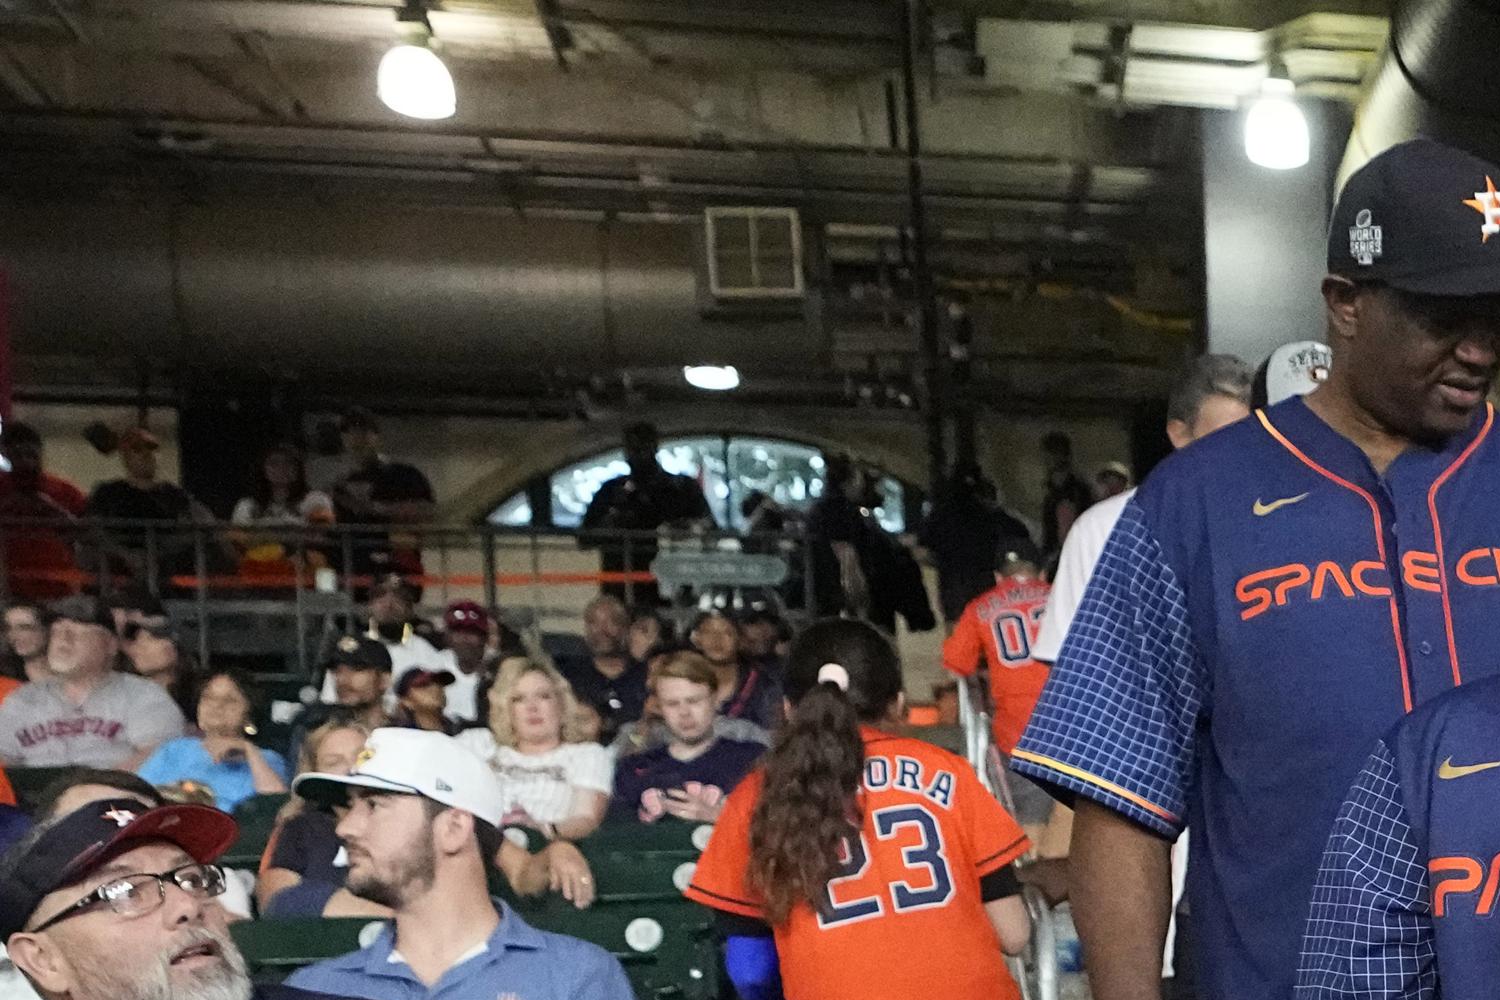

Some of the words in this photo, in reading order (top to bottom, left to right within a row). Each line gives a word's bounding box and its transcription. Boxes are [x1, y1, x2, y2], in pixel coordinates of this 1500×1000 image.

[1350, 227, 1382, 241] WORLD
[1350, 241, 1382, 254] SERIES
[1236, 550, 1443, 621] SPACE
[990, 607, 1049, 668] 0
[862, 755, 957, 811] ORA
[816, 803, 956, 930] 23
